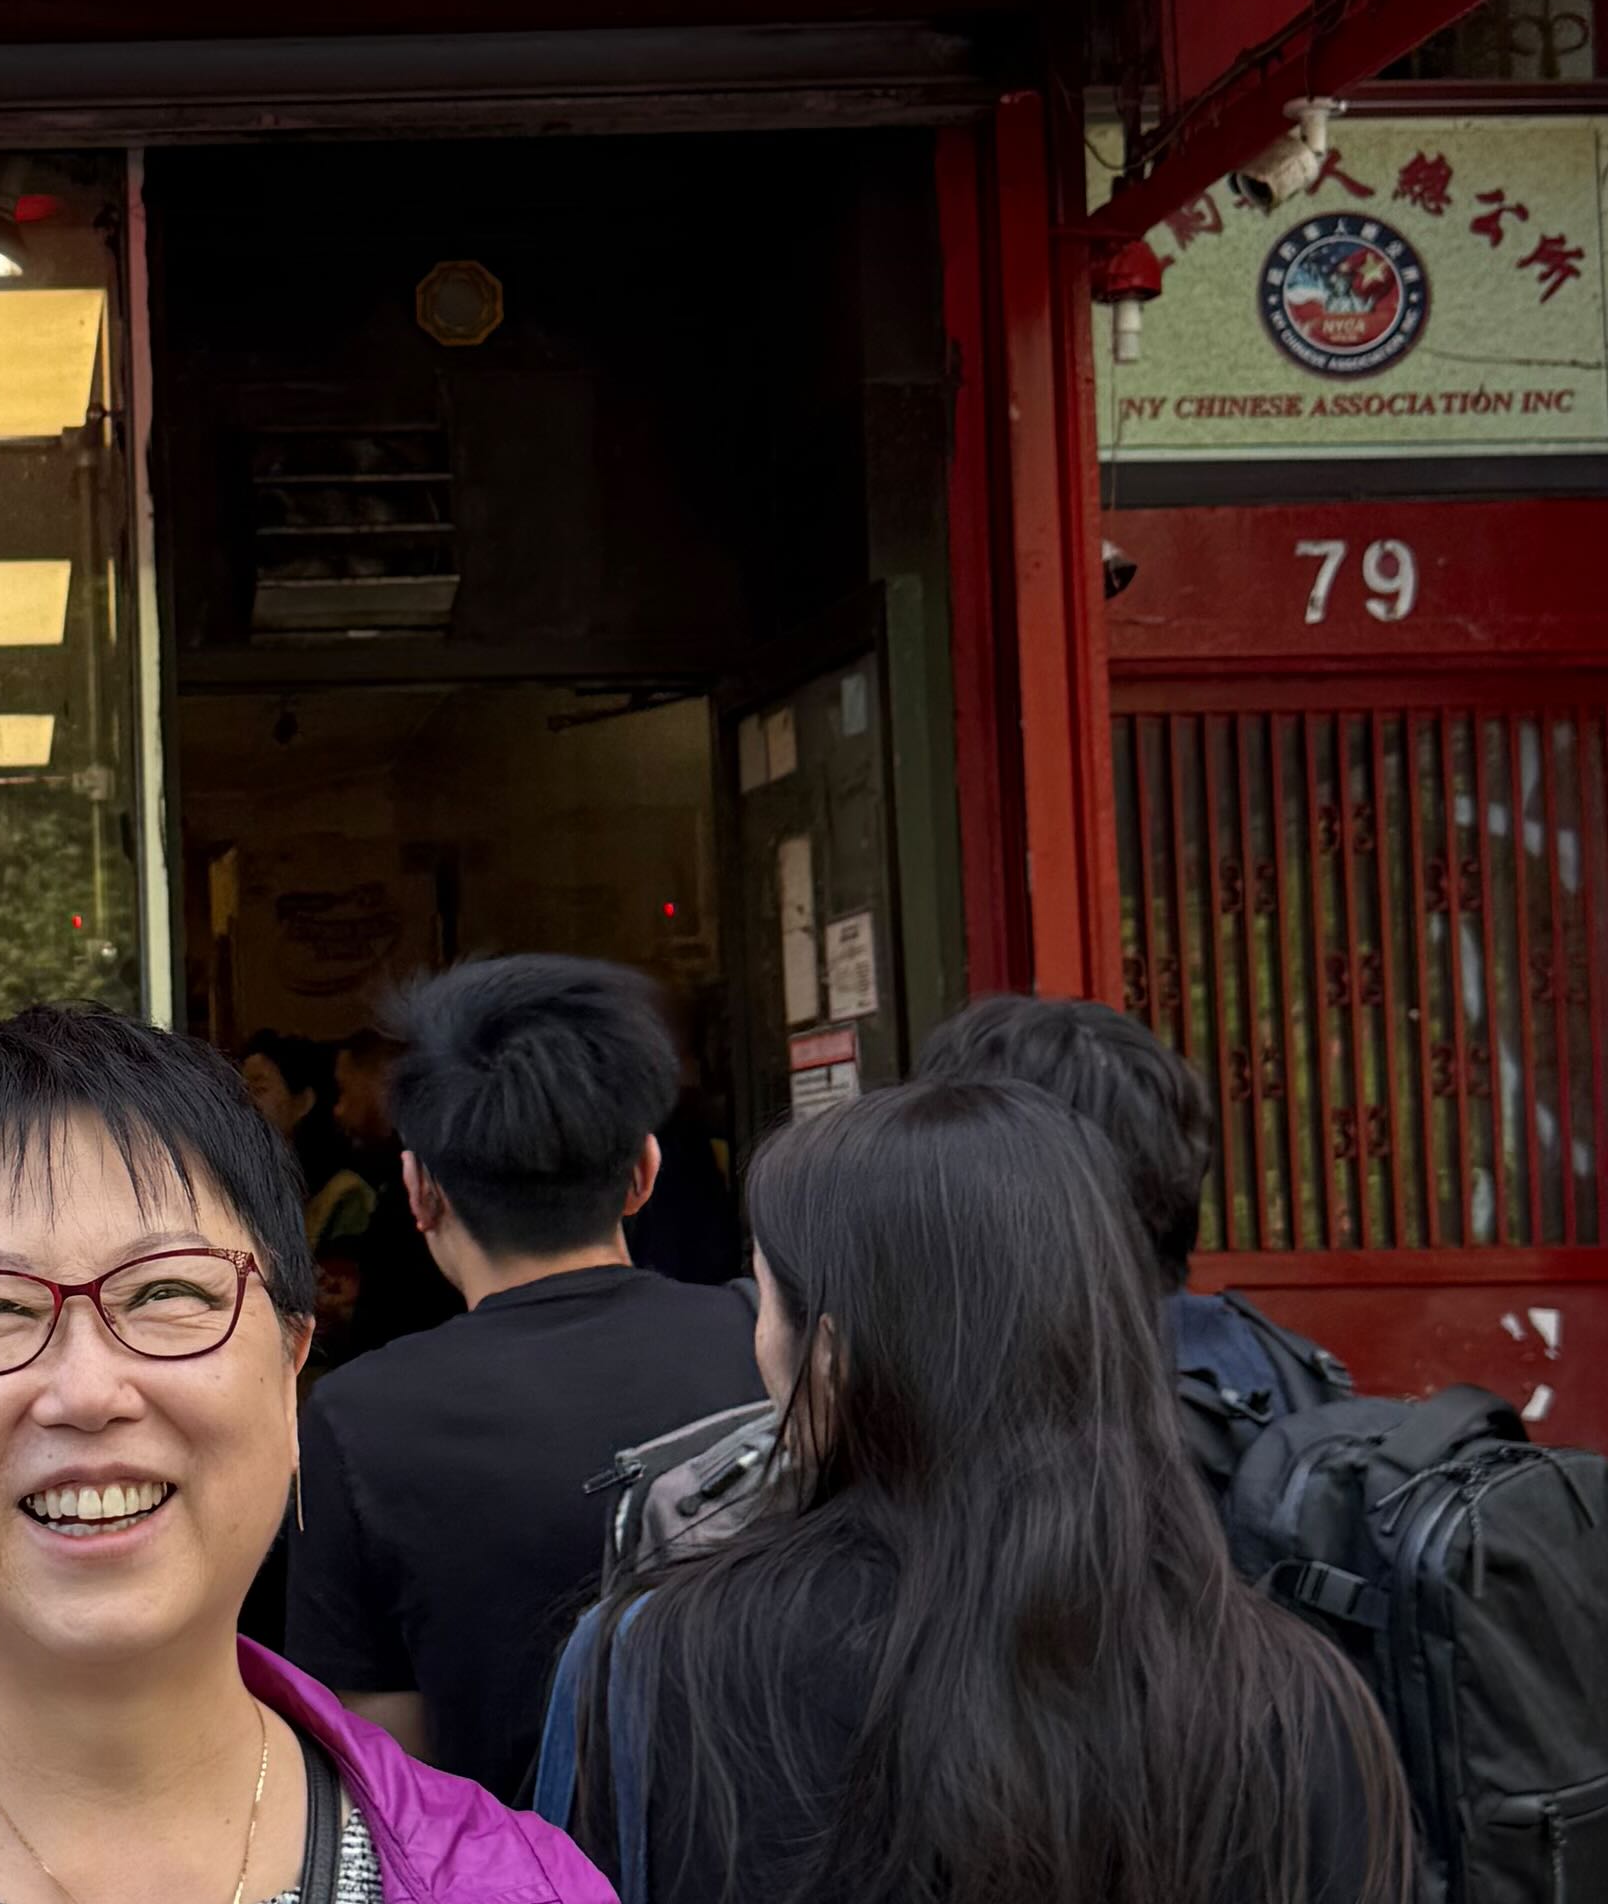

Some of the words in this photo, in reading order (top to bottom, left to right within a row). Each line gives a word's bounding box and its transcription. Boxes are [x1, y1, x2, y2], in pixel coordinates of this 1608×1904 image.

[1120, 396, 1167, 419] NY
[1173, 393, 1304, 419] CHINESE
[1308, 389, 1514, 418] ASSOCIATION
[1520, 388, 1575, 415] INC
[1294, 539, 1416, 624] 79
